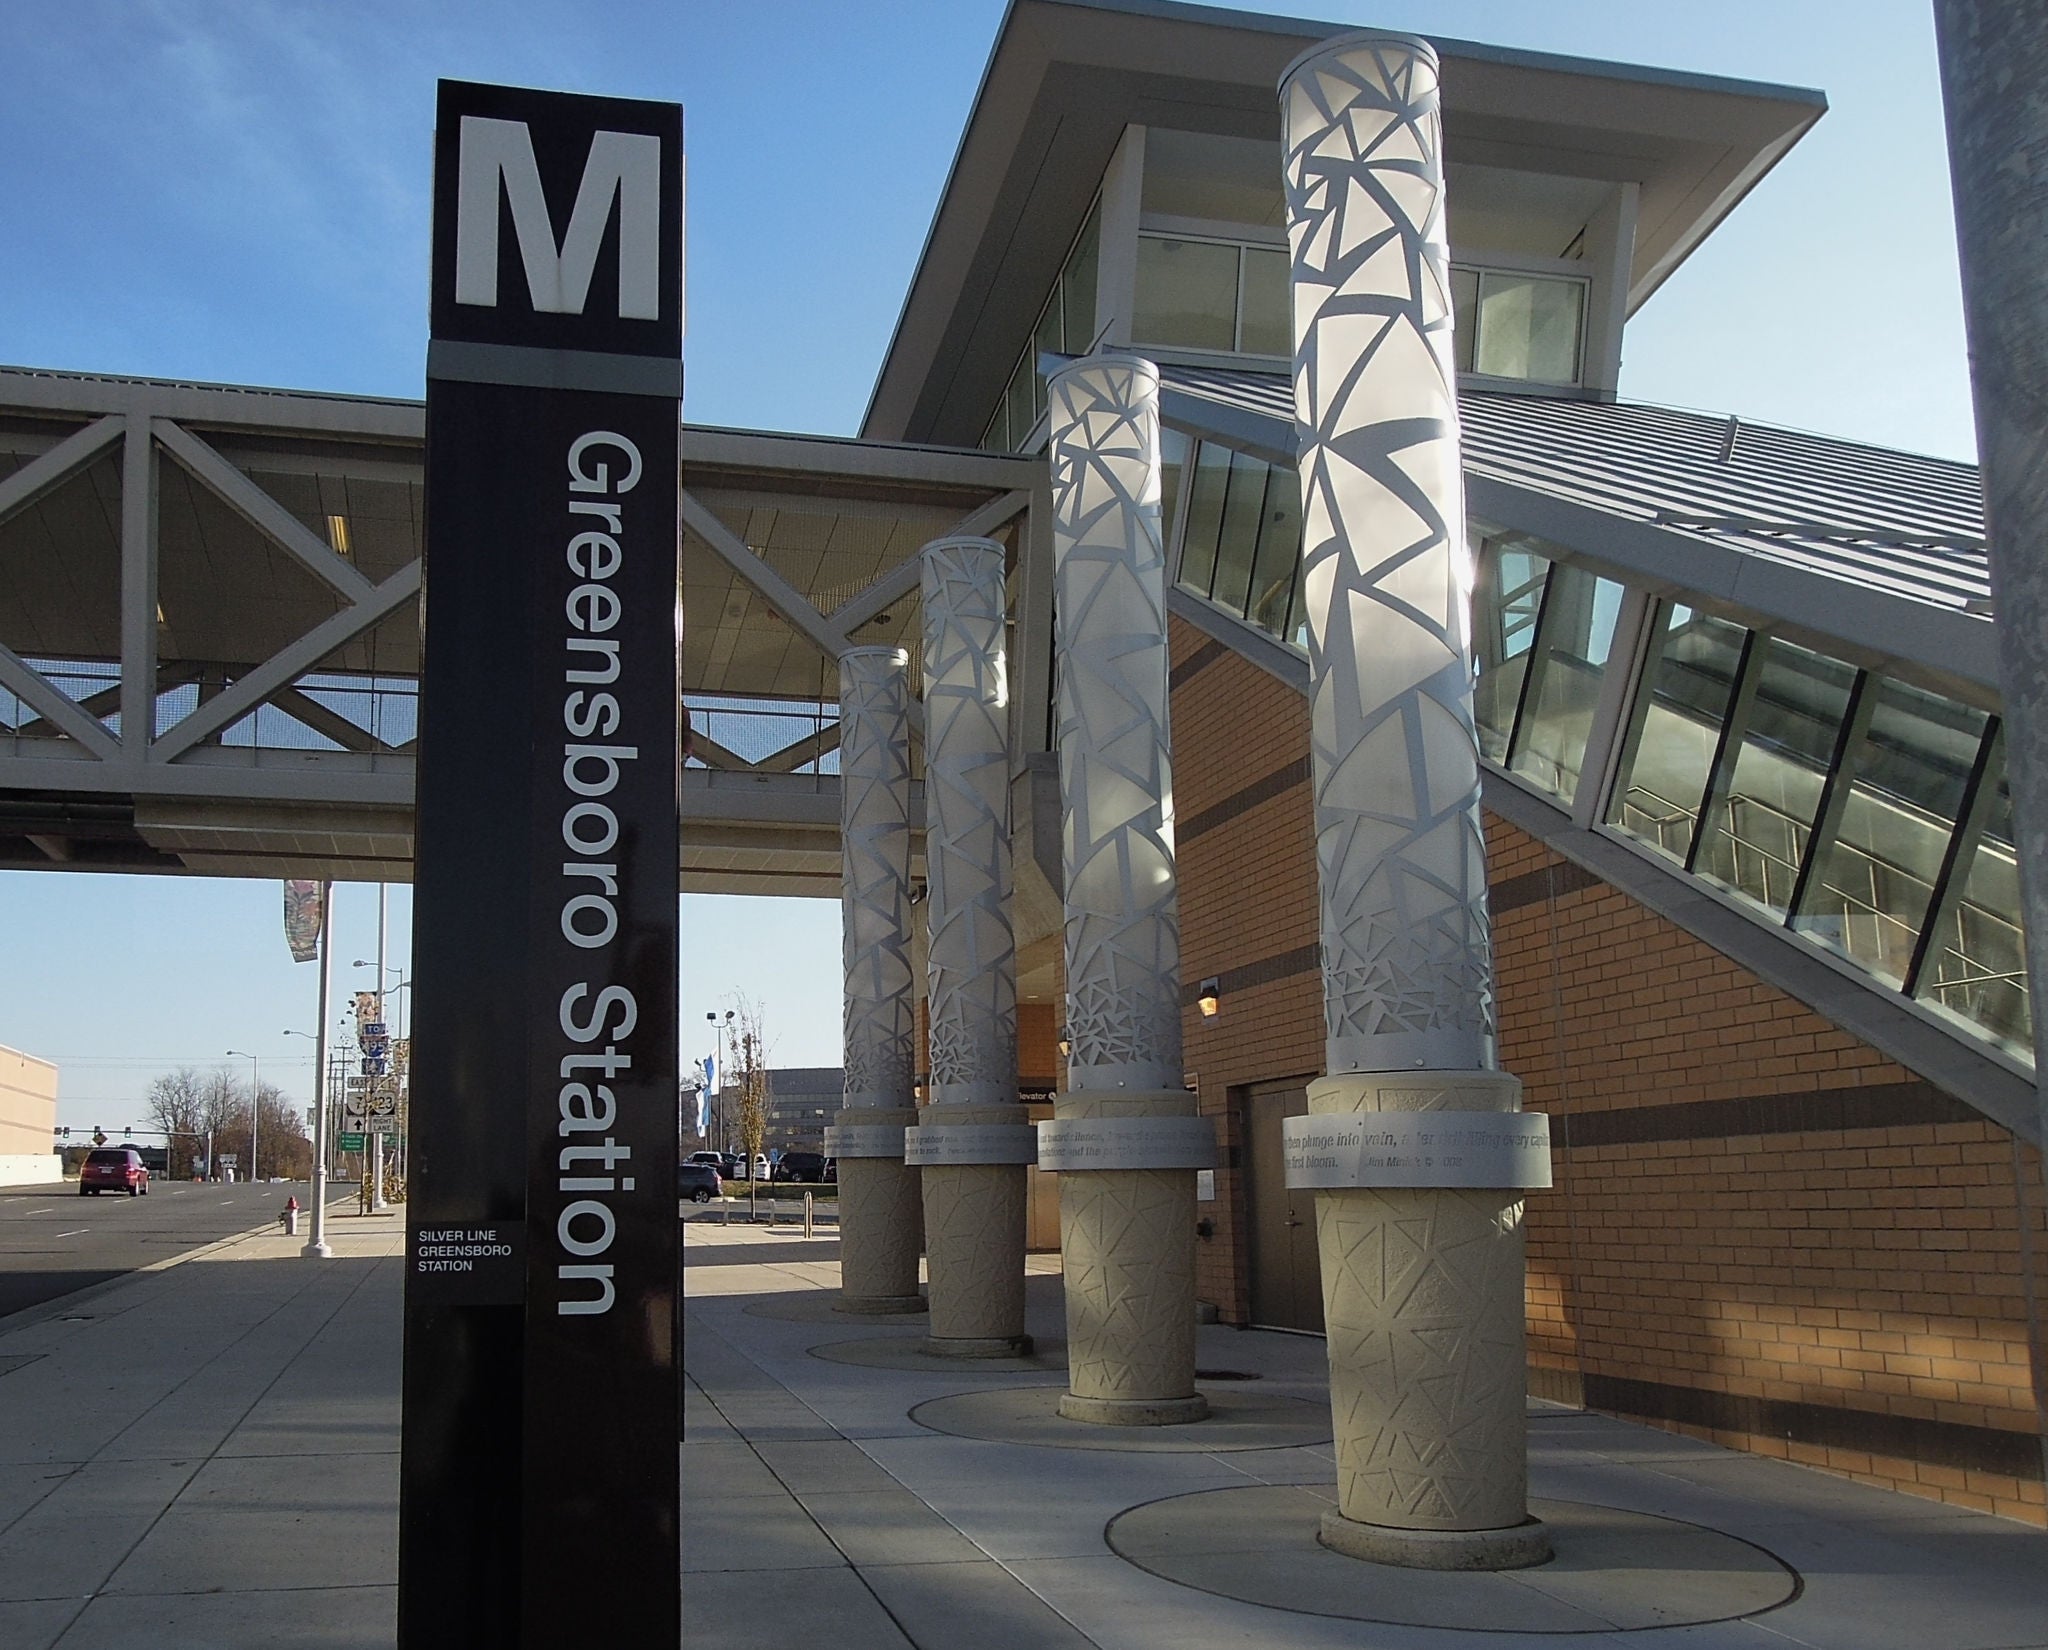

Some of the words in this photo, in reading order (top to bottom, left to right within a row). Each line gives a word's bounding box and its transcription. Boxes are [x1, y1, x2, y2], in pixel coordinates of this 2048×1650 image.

[456, 115, 660, 321] M
[560, 430, 643, 949] Greensboro
[367, 1025, 380, 1033] TO
[351, 1078, 365, 1086] EAS
[1017, 1091, 1047, 1101] levator
[356, 1096, 364, 1110] 7
[1302, 1133, 1334, 1151] plunge
[1336, 1132, 1360, 1146] into
[557, 982, 638, 1316] Station
[1306, 1154, 1339, 1168] bloom.
[1368, 1155, 1384, 1168] Jim
[419, 1231, 464, 1242] SILVER
[467, 1230, 497, 1241] LINE
[418, 1245, 512, 1257] GREENSBORO
[418, 1260, 473, 1272] STATION
